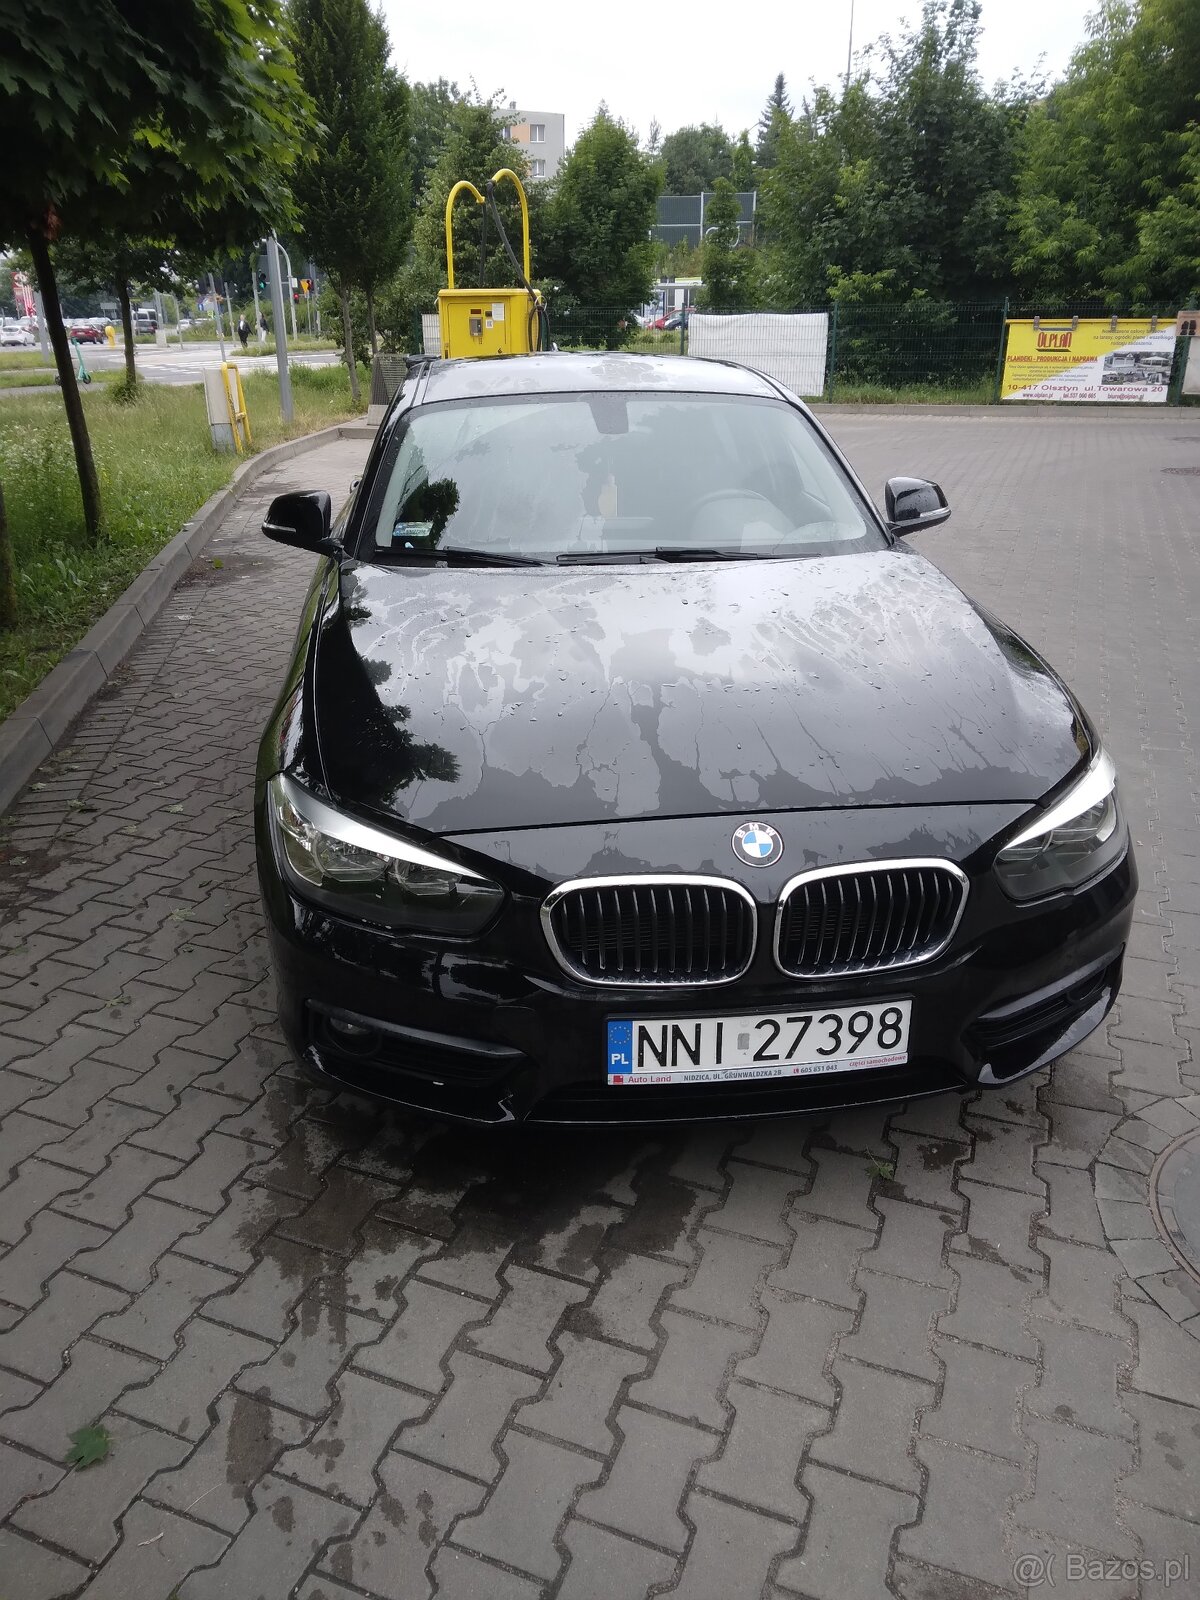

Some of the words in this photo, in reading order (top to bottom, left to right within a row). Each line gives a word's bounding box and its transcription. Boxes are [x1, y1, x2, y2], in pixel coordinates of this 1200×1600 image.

[1037, 331, 1072, 348] OLPLAN
[1071, 355, 1098, 363] NAPRAWA
[1041, 384, 1079, 392] Olsztyn
[735, 822, 776, 839] BMW
[637, 1022, 724, 1068] NNI
[752, 1007, 903, 1062] 27398
[611, 1053, 629, 1065] PL
[866, 1055, 906, 1065] samochodowe
[724, 1070, 773, 1080] GRUNWALDZKA
[800, 1066, 812, 1074] 605
[627, 1075, 648, 1084] Auto
[650, 1075, 672, 1084] Land
